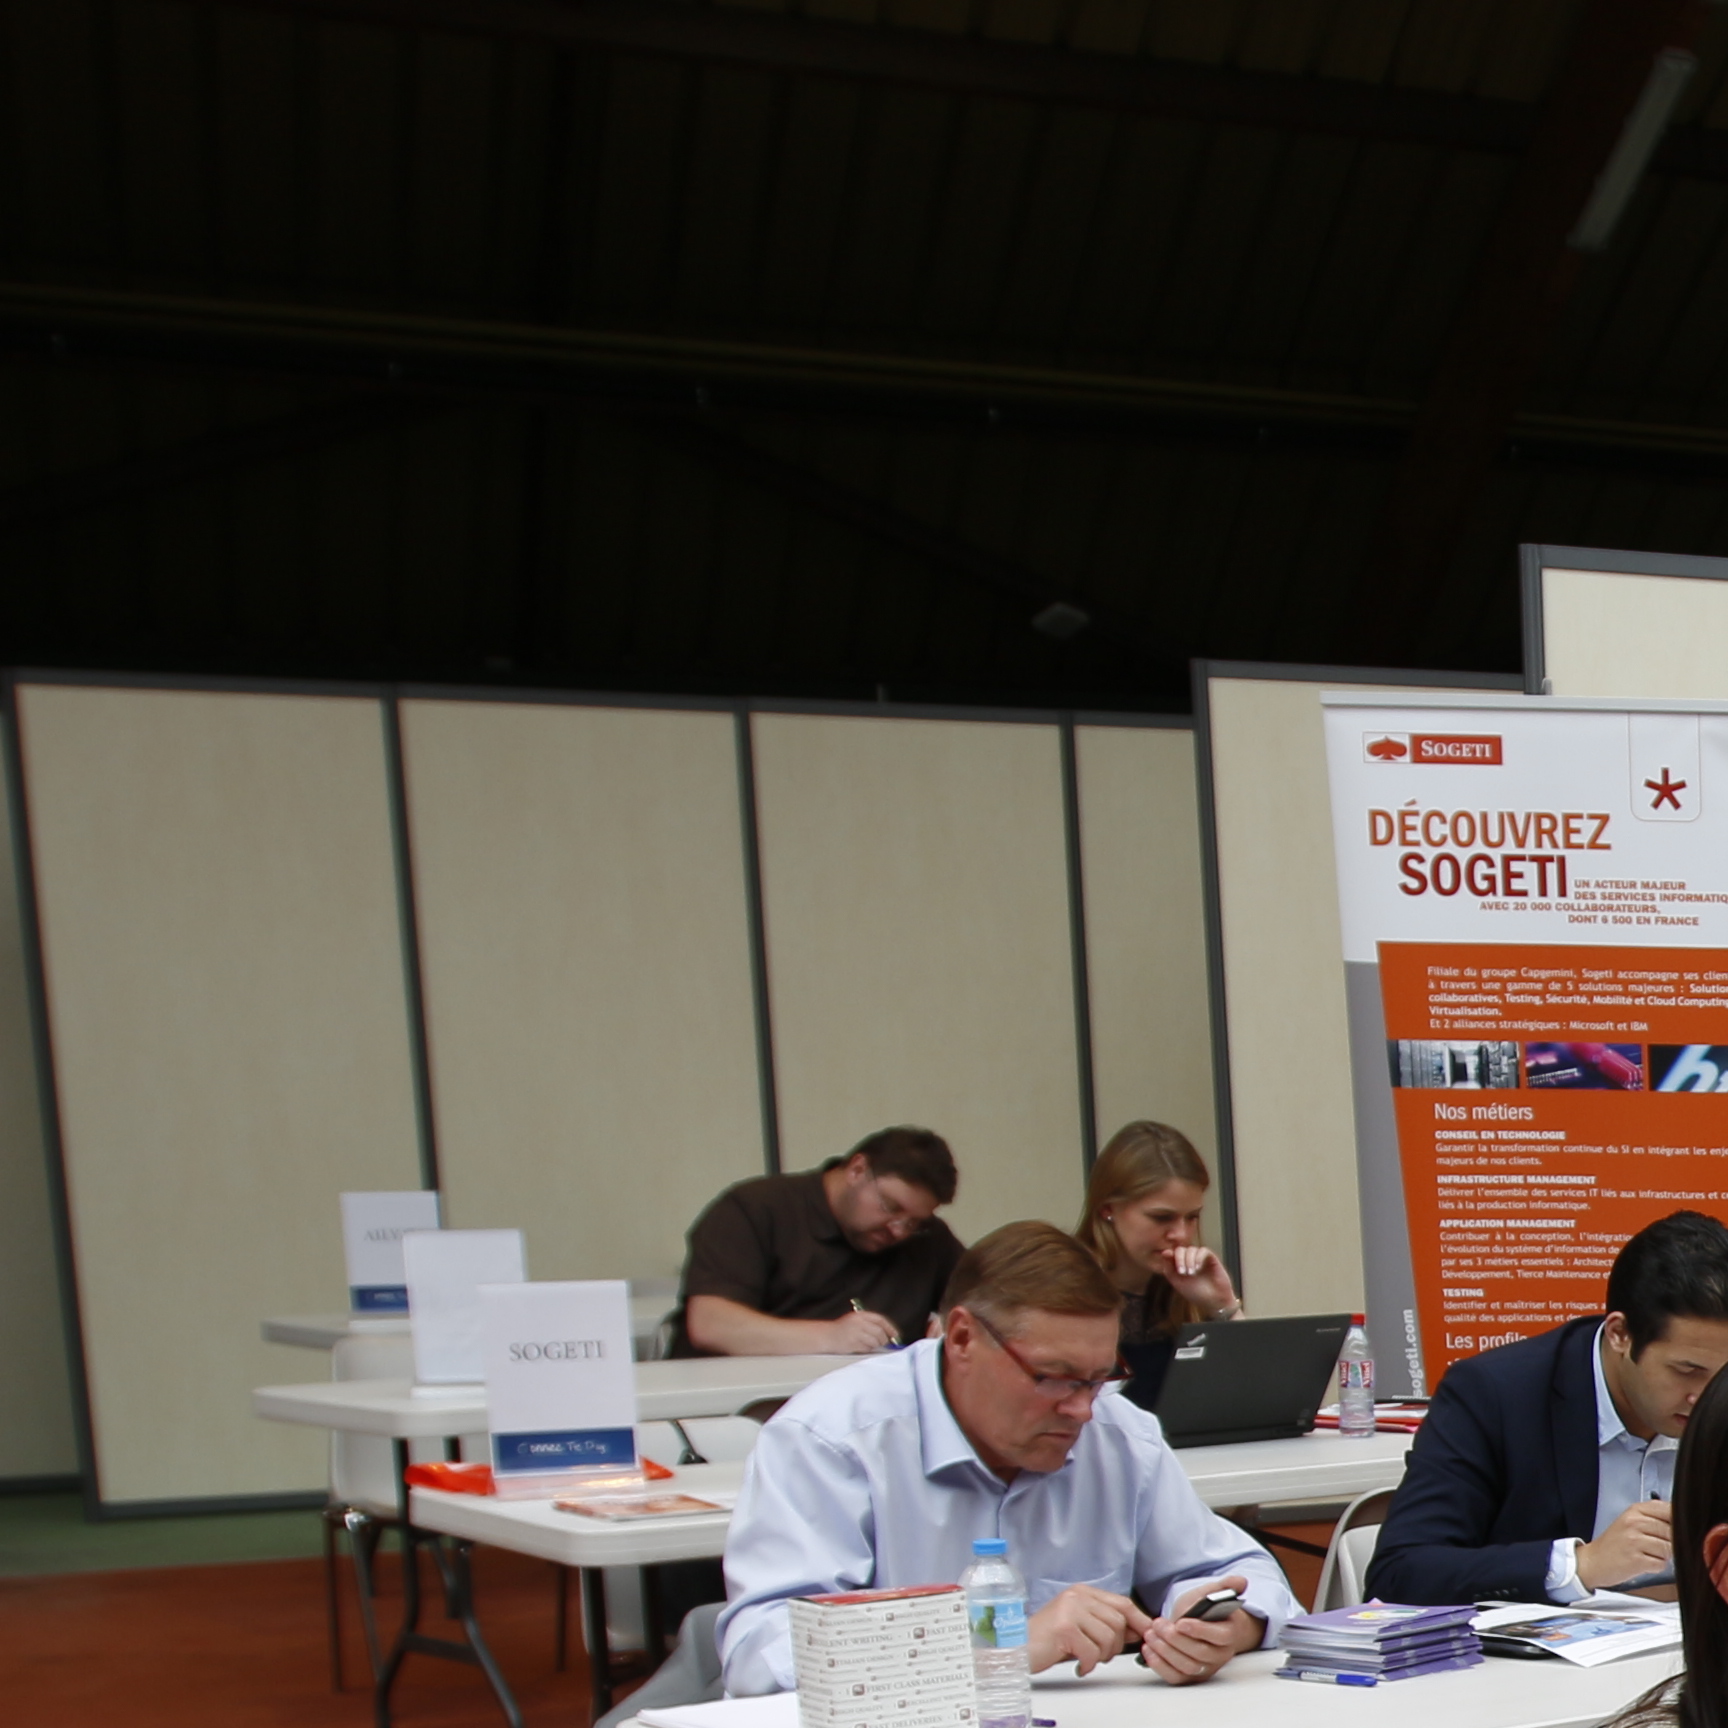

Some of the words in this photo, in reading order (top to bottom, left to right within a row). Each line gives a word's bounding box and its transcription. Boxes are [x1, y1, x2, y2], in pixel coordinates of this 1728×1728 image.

[1368, 800, 1612, 850] DÉCOUVREZ
[1398, 852, 1567, 898] SOGETI
[1574, 880, 1590, 888] UN
[1594, 880, 1637, 889] ACTEUR
[1640, 881, 1685, 891] MAJEUR
[1574, 891, 1596, 900] DES
[1600, 892, 1655, 902] SERVICES
[1480, 902, 1509, 911] AVEC
[1513, 902, 1527, 911] 20
[1531, 902, 1551, 911] 000
[1568, 915, 1597, 924] DONT
[1602, 916, 1607, 925] 6
[1612, 916, 1632, 925] 500
[1636, 916, 1651, 925] EN
[1655, 916, 1699, 926] FRANCE
[1427, 966, 1458, 976] Filiale
[1464, 967, 1476, 977] du
[1481, 969, 1516, 978] groupe
[1582, 969, 1612, 979] Sogeti
[1618, 971, 1678, 981] accompagne
[1683, 972, 1698, 980] ses
[1440, 981, 1476, 990] travers
[1482, 982, 1500, 990] une
[1506, 982, 1542, 992] gamme
[1548, 981, 1561, 990] de
[1579, 982, 1622, 991] solutions
[1629, 982, 1674, 994] majeures
[1648, 996, 1674, 1006] Cloud
[1430, 1019, 1440, 1028] Et
[1444, 1019, 1450, 1028] 2
[1453, 1019, 1496, 1029] alliances
[1499, 1020, 1559, 1031] stratégiques
[1570, 1020, 1613, 1030] Microsoft
[1617, 1021, 1627, 1030] et
[1630, 1021, 1648, 1031] IBM
[1435, 1103, 1466, 1120] Nos
[1472, 1103, 1533, 1120] métiers
[1435, 1131, 1478, 1140] CONSEIL
[1481, 1131, 1494, 1140] EN
[1497, 1131, 1565, 1140] TECHNOLOGIE
[1437, 1175, 1524, 1184] INFRASTRUCTURE
[1527, 1176, 1595, 1185] MANAGEMENT
[1440, 1219, 1503, 1228] APPLICATION
[1506, 1220, 1574, 1229] MANAGEMENT
[1443, 1289, 1484, 1297] TESTING
[1446, 1333, 1473, 1348] Les
[510, 1340, 603, 1362] SOGETI
